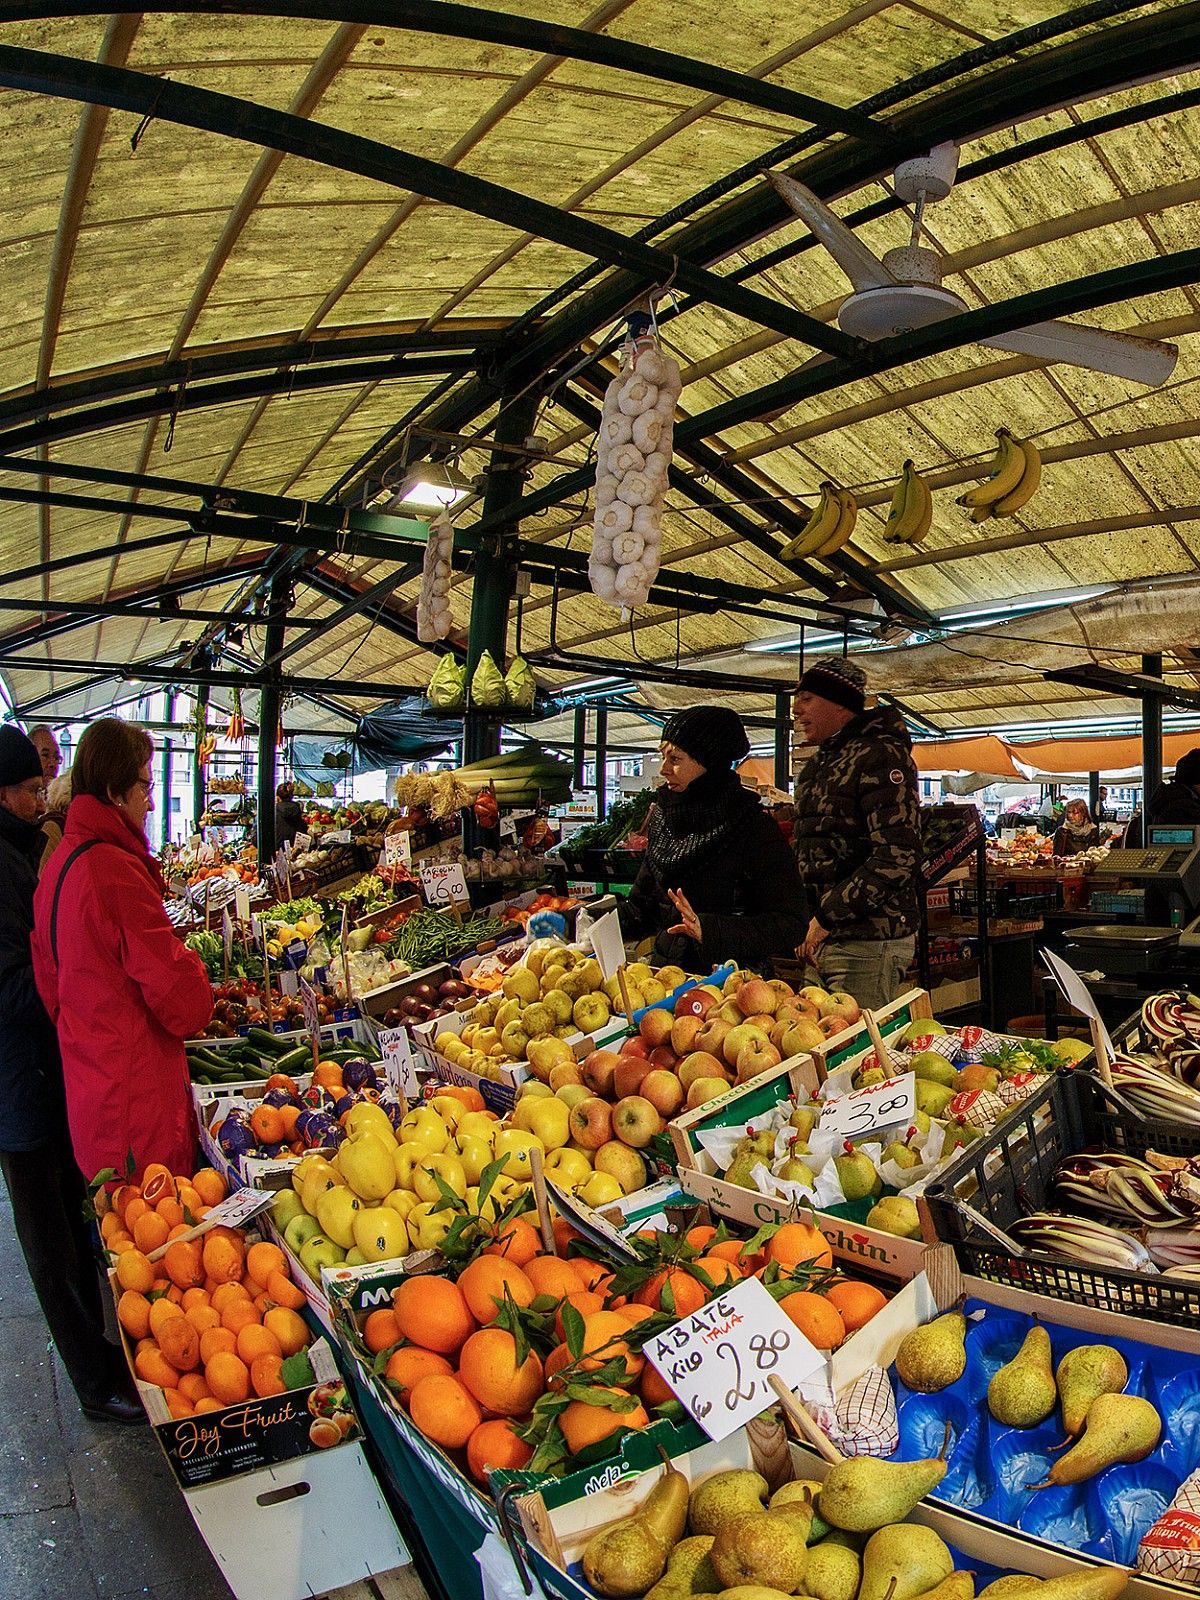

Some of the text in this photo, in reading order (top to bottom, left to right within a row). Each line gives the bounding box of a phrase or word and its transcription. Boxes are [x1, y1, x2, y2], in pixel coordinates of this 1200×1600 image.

[656, 1295, 736, 1362] ABATE
[175, 1421, 222, 1459] Joy
[220, 1402, 297, 1438] Fruit
[584, 1465, 621, 1496] Mela
